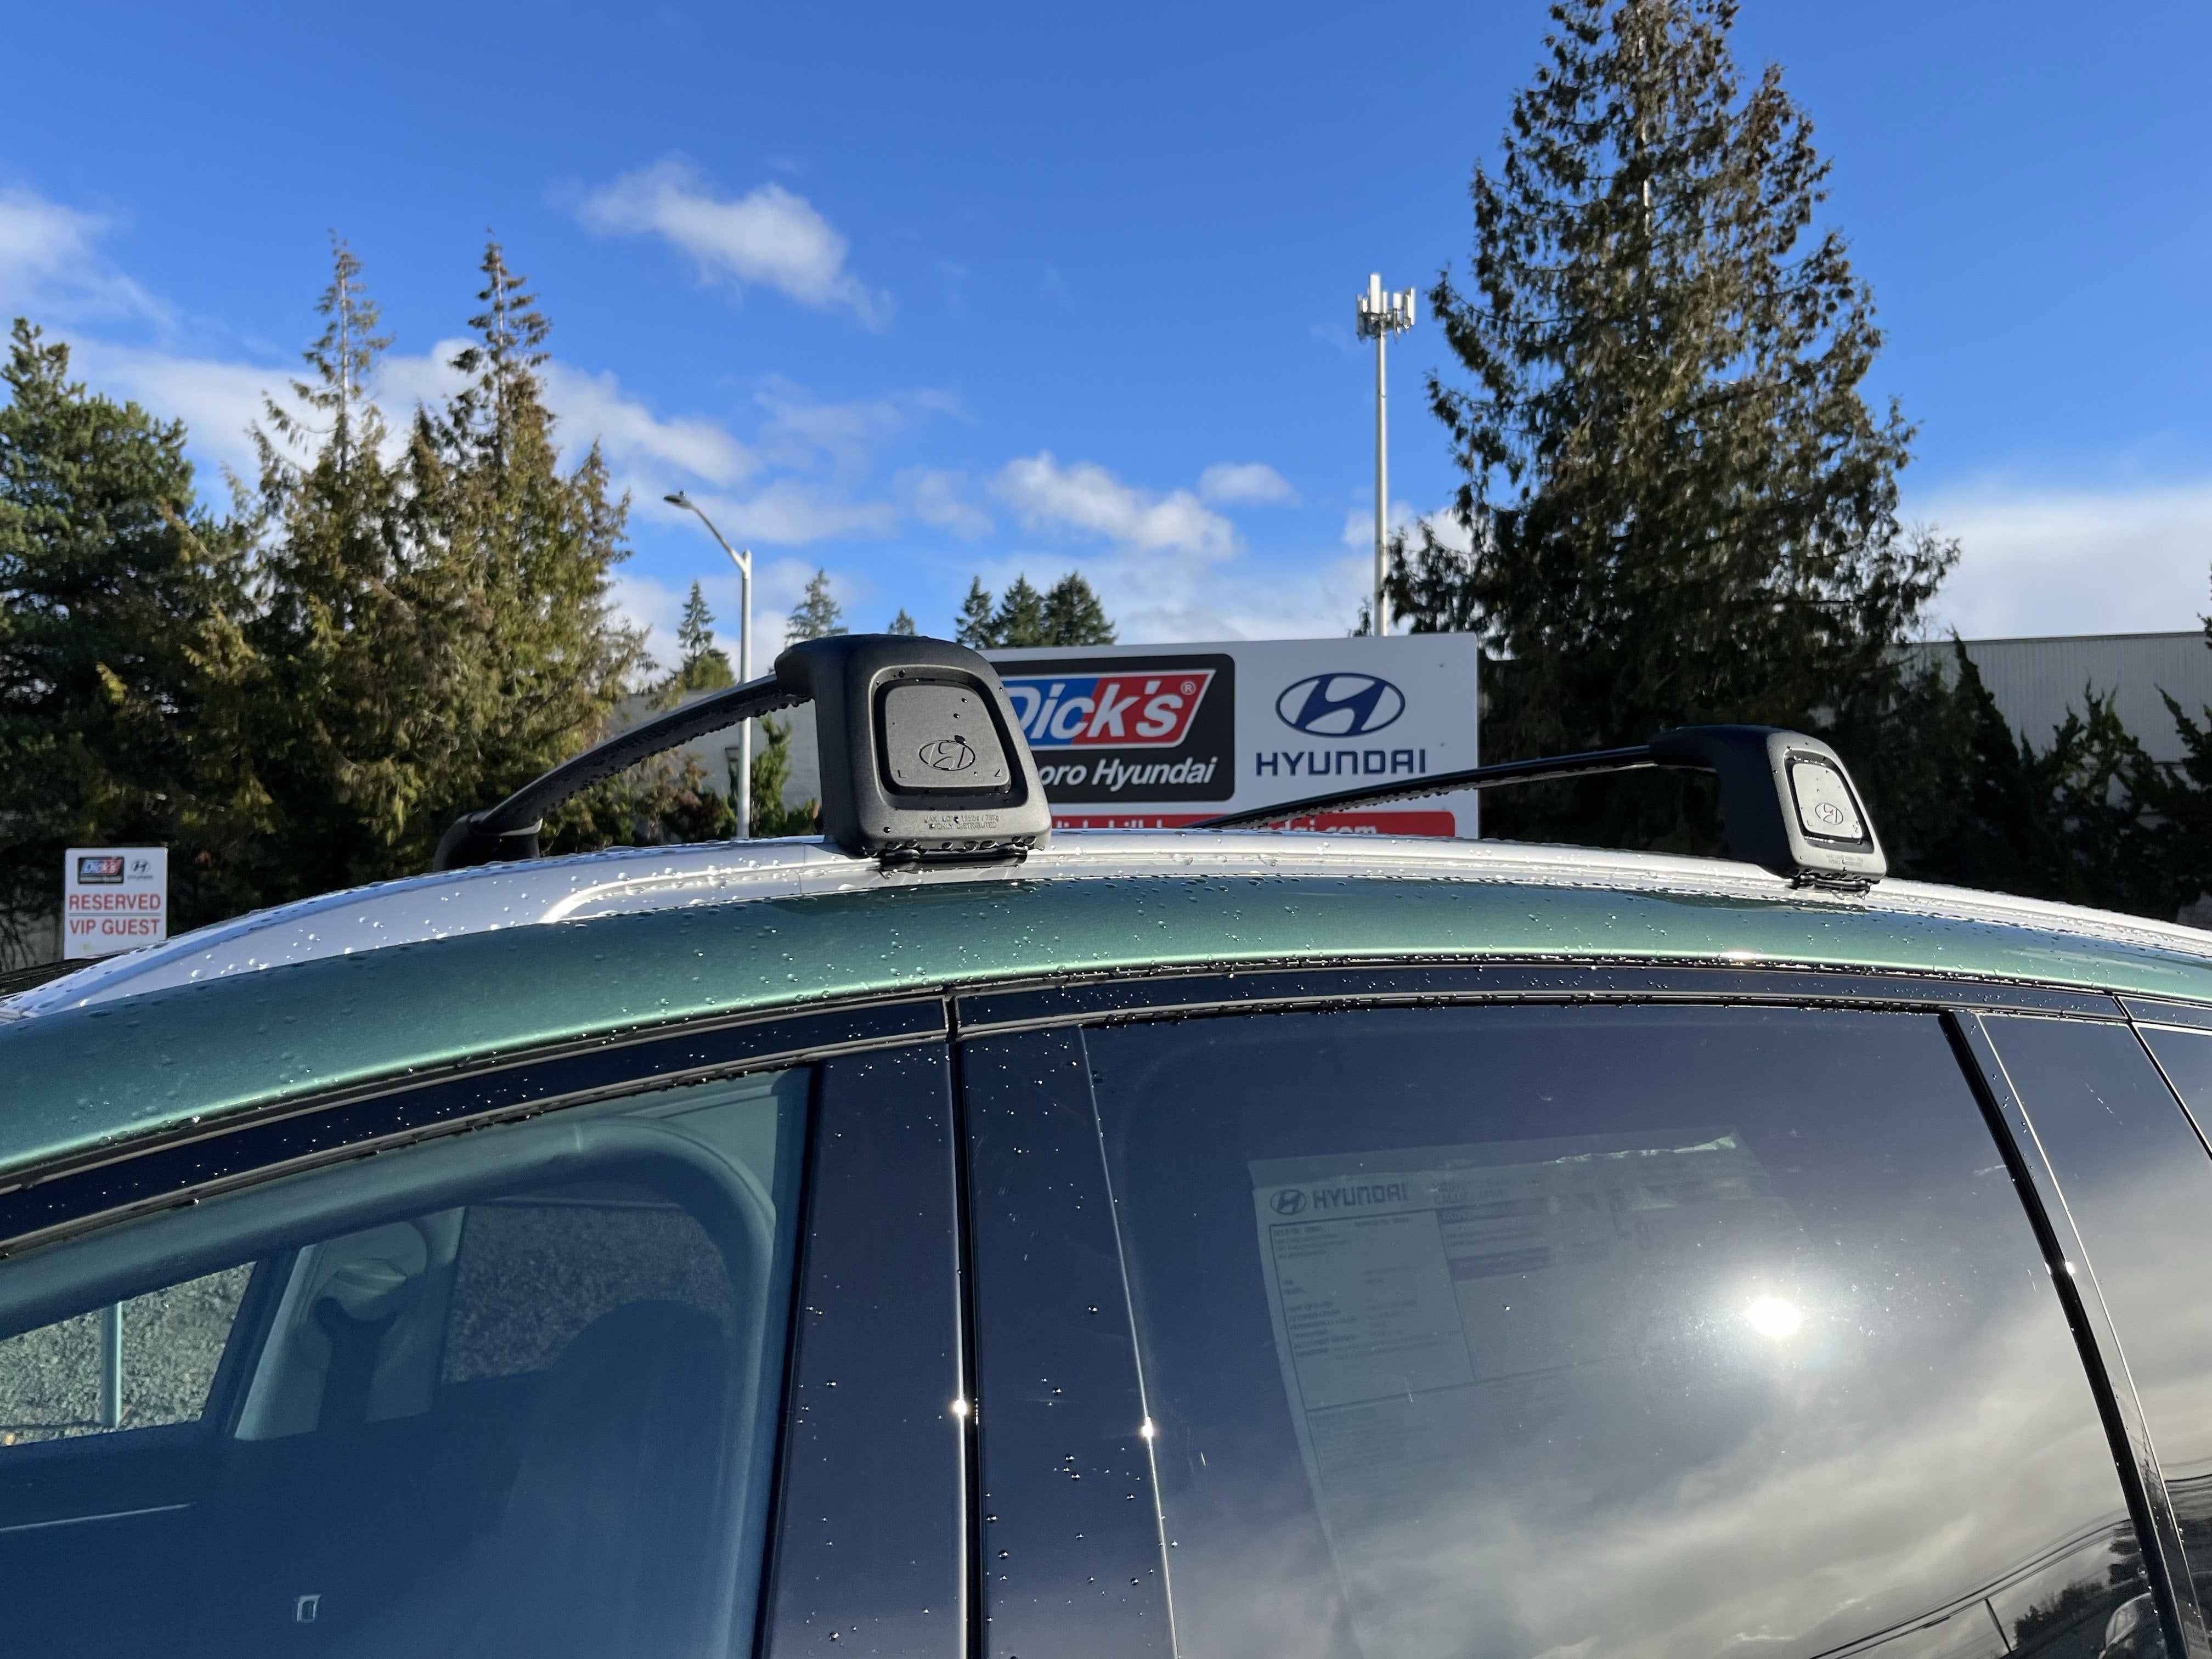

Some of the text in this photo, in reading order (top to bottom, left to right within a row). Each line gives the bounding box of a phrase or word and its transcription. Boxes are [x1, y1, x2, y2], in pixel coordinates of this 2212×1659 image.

[1091, 756, 1218, 792] Hyundai
[1256, 749, 1426, 776] HYUNDAI
[69, 893, 161, 911] RESERVED
[70, 918, 160, 935] VIP GUEST
[1312, 1182, 1408, 1210] HYUNDAI
